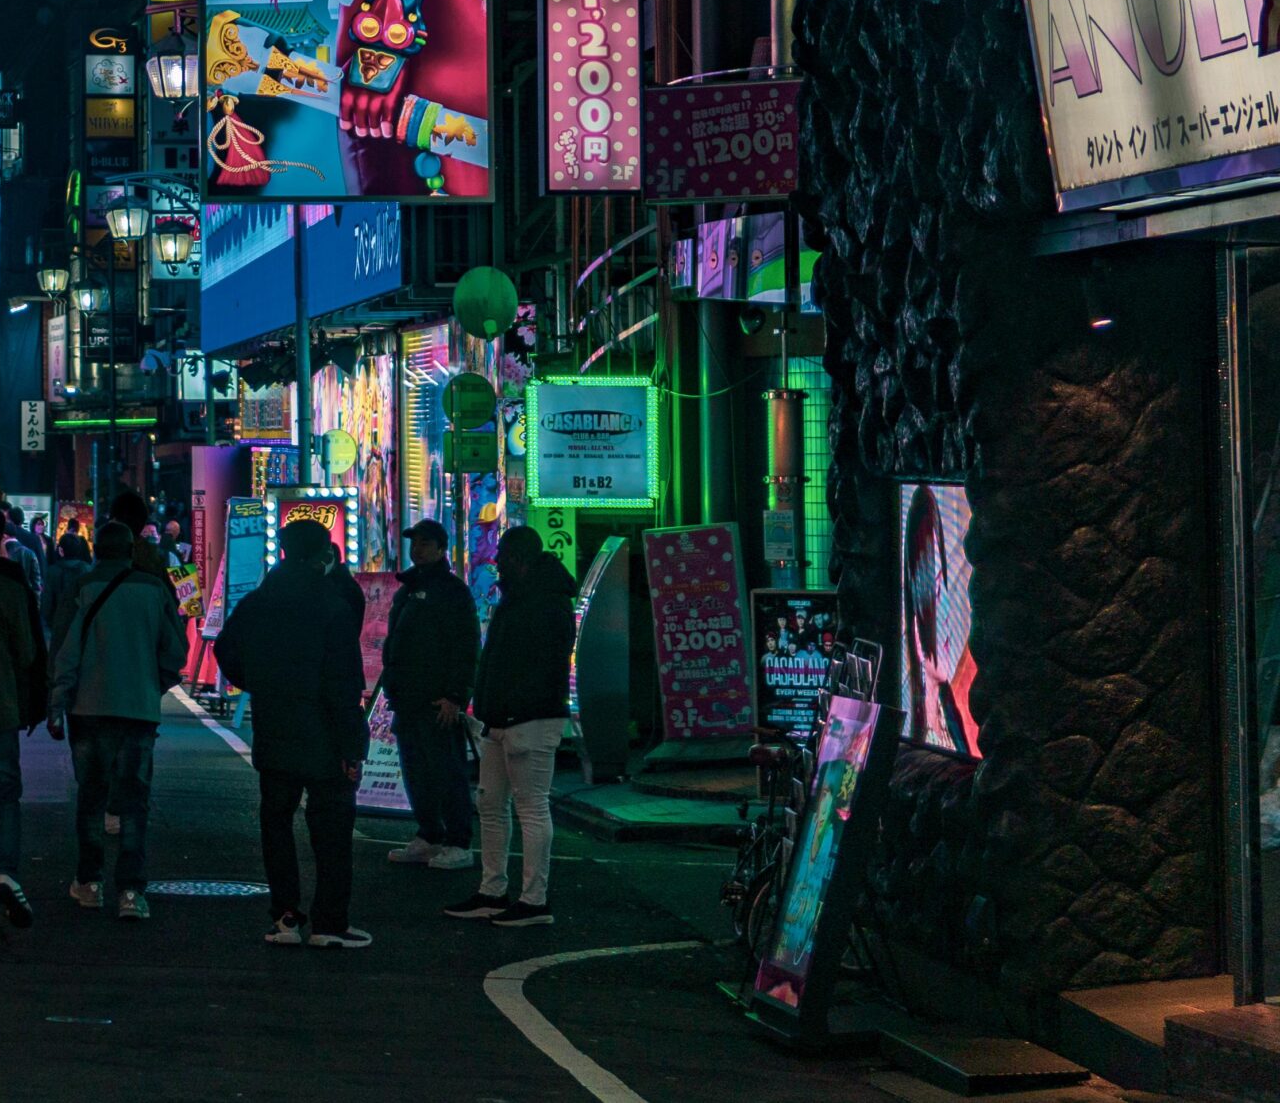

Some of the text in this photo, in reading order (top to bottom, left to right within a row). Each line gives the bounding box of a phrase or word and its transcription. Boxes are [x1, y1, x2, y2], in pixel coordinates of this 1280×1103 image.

[1086, 127, 1123, 170] タレント
[1128, 122, 1148, 159] イン
[611, 165, 635, 181] 2F
[656, 168, 687, 194] 2F
[27, 401, 40, 449] とんかつ
[543, 413, 640, 432] CASABLANCA
[573, 476, 587, 489] B1
[597, 476, 612, 489] B2
[669, 708, 699, 729] 2F
